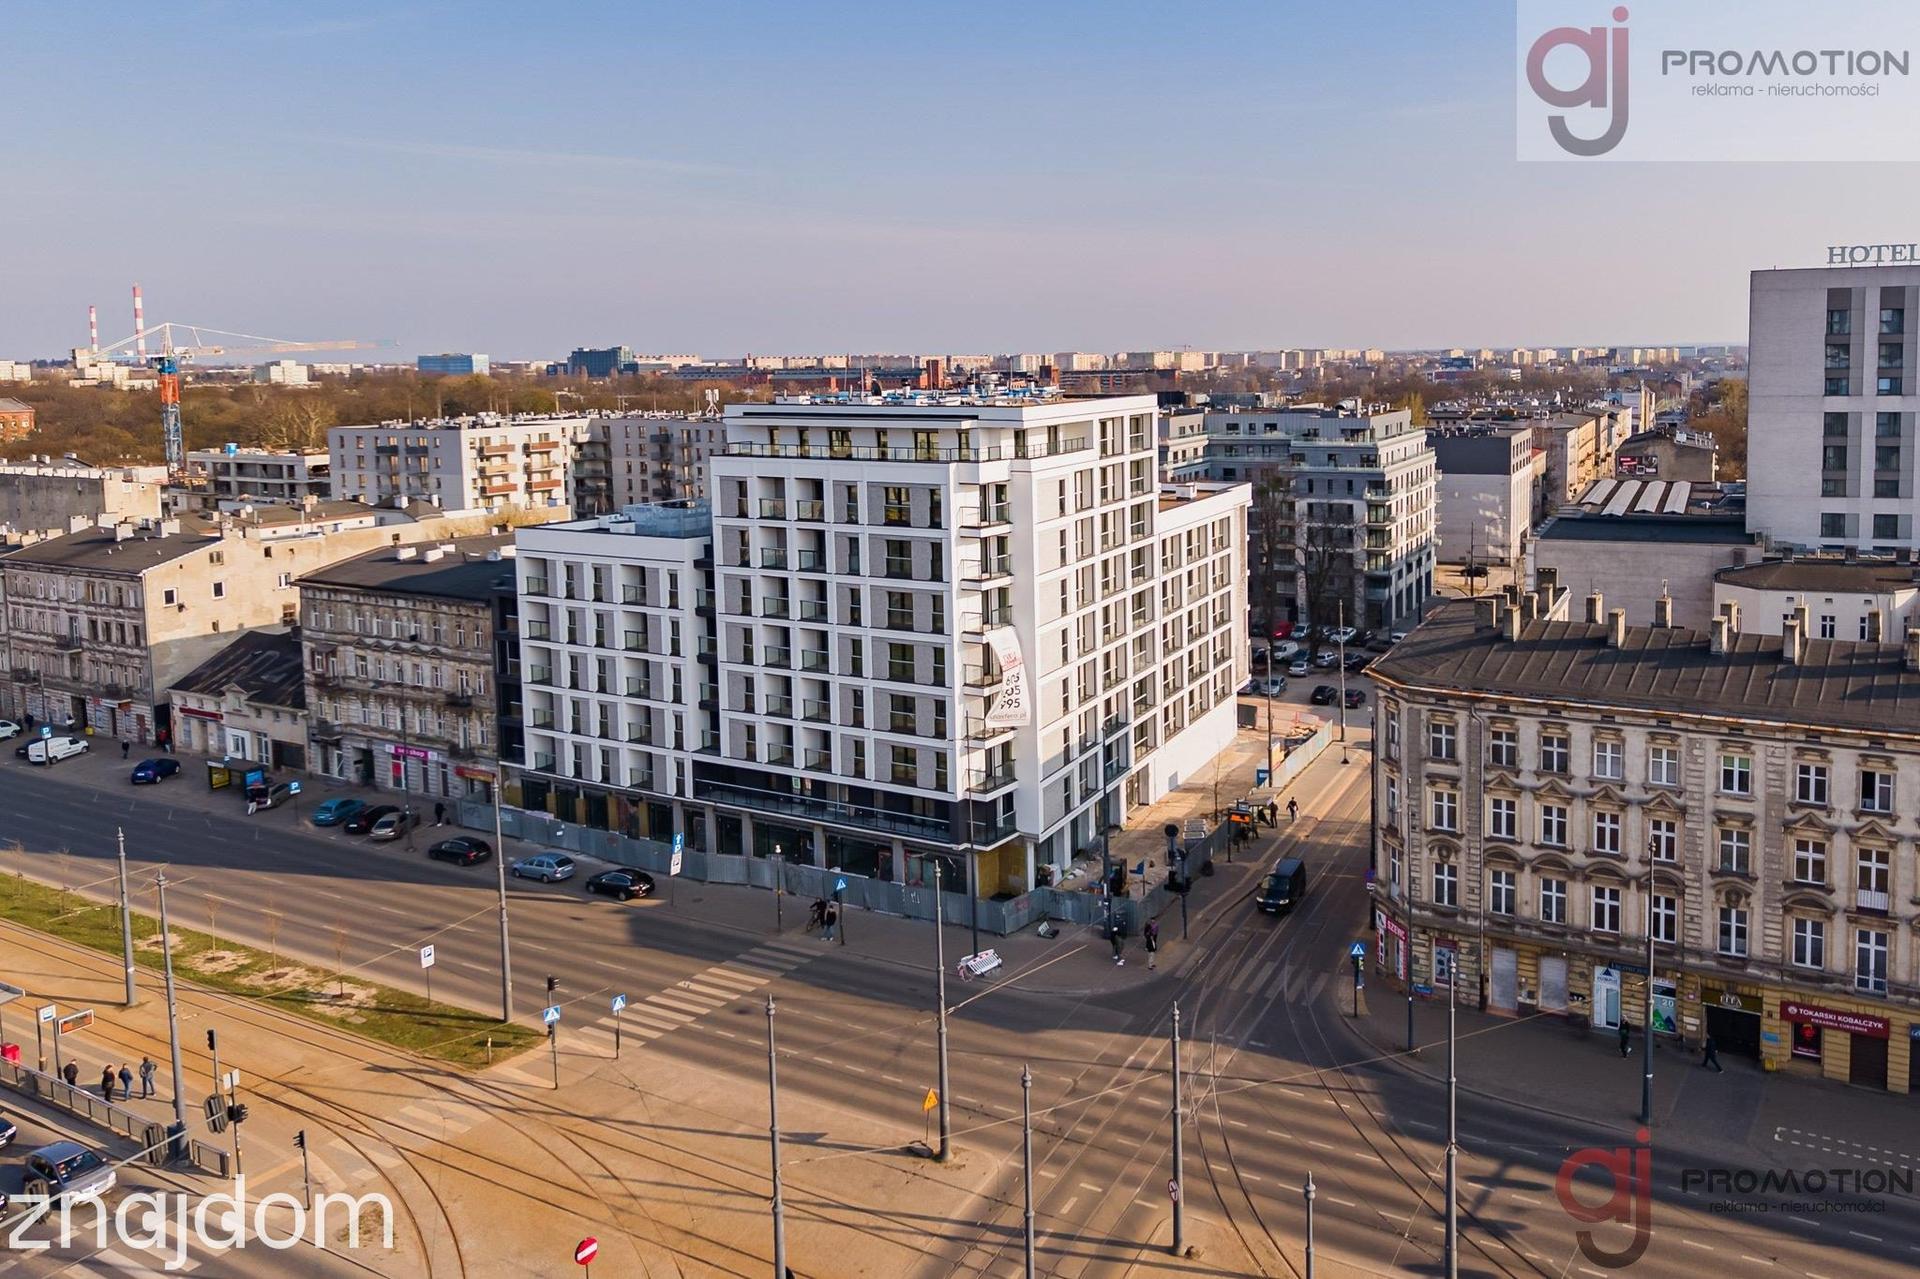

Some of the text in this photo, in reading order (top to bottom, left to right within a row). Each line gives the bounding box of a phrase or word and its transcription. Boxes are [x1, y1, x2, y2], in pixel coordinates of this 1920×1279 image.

[1827, 244, 1920, 264] HOTEL
[1799, 1008, 1884, 1030] TOKARSKI KOBALCZYK
